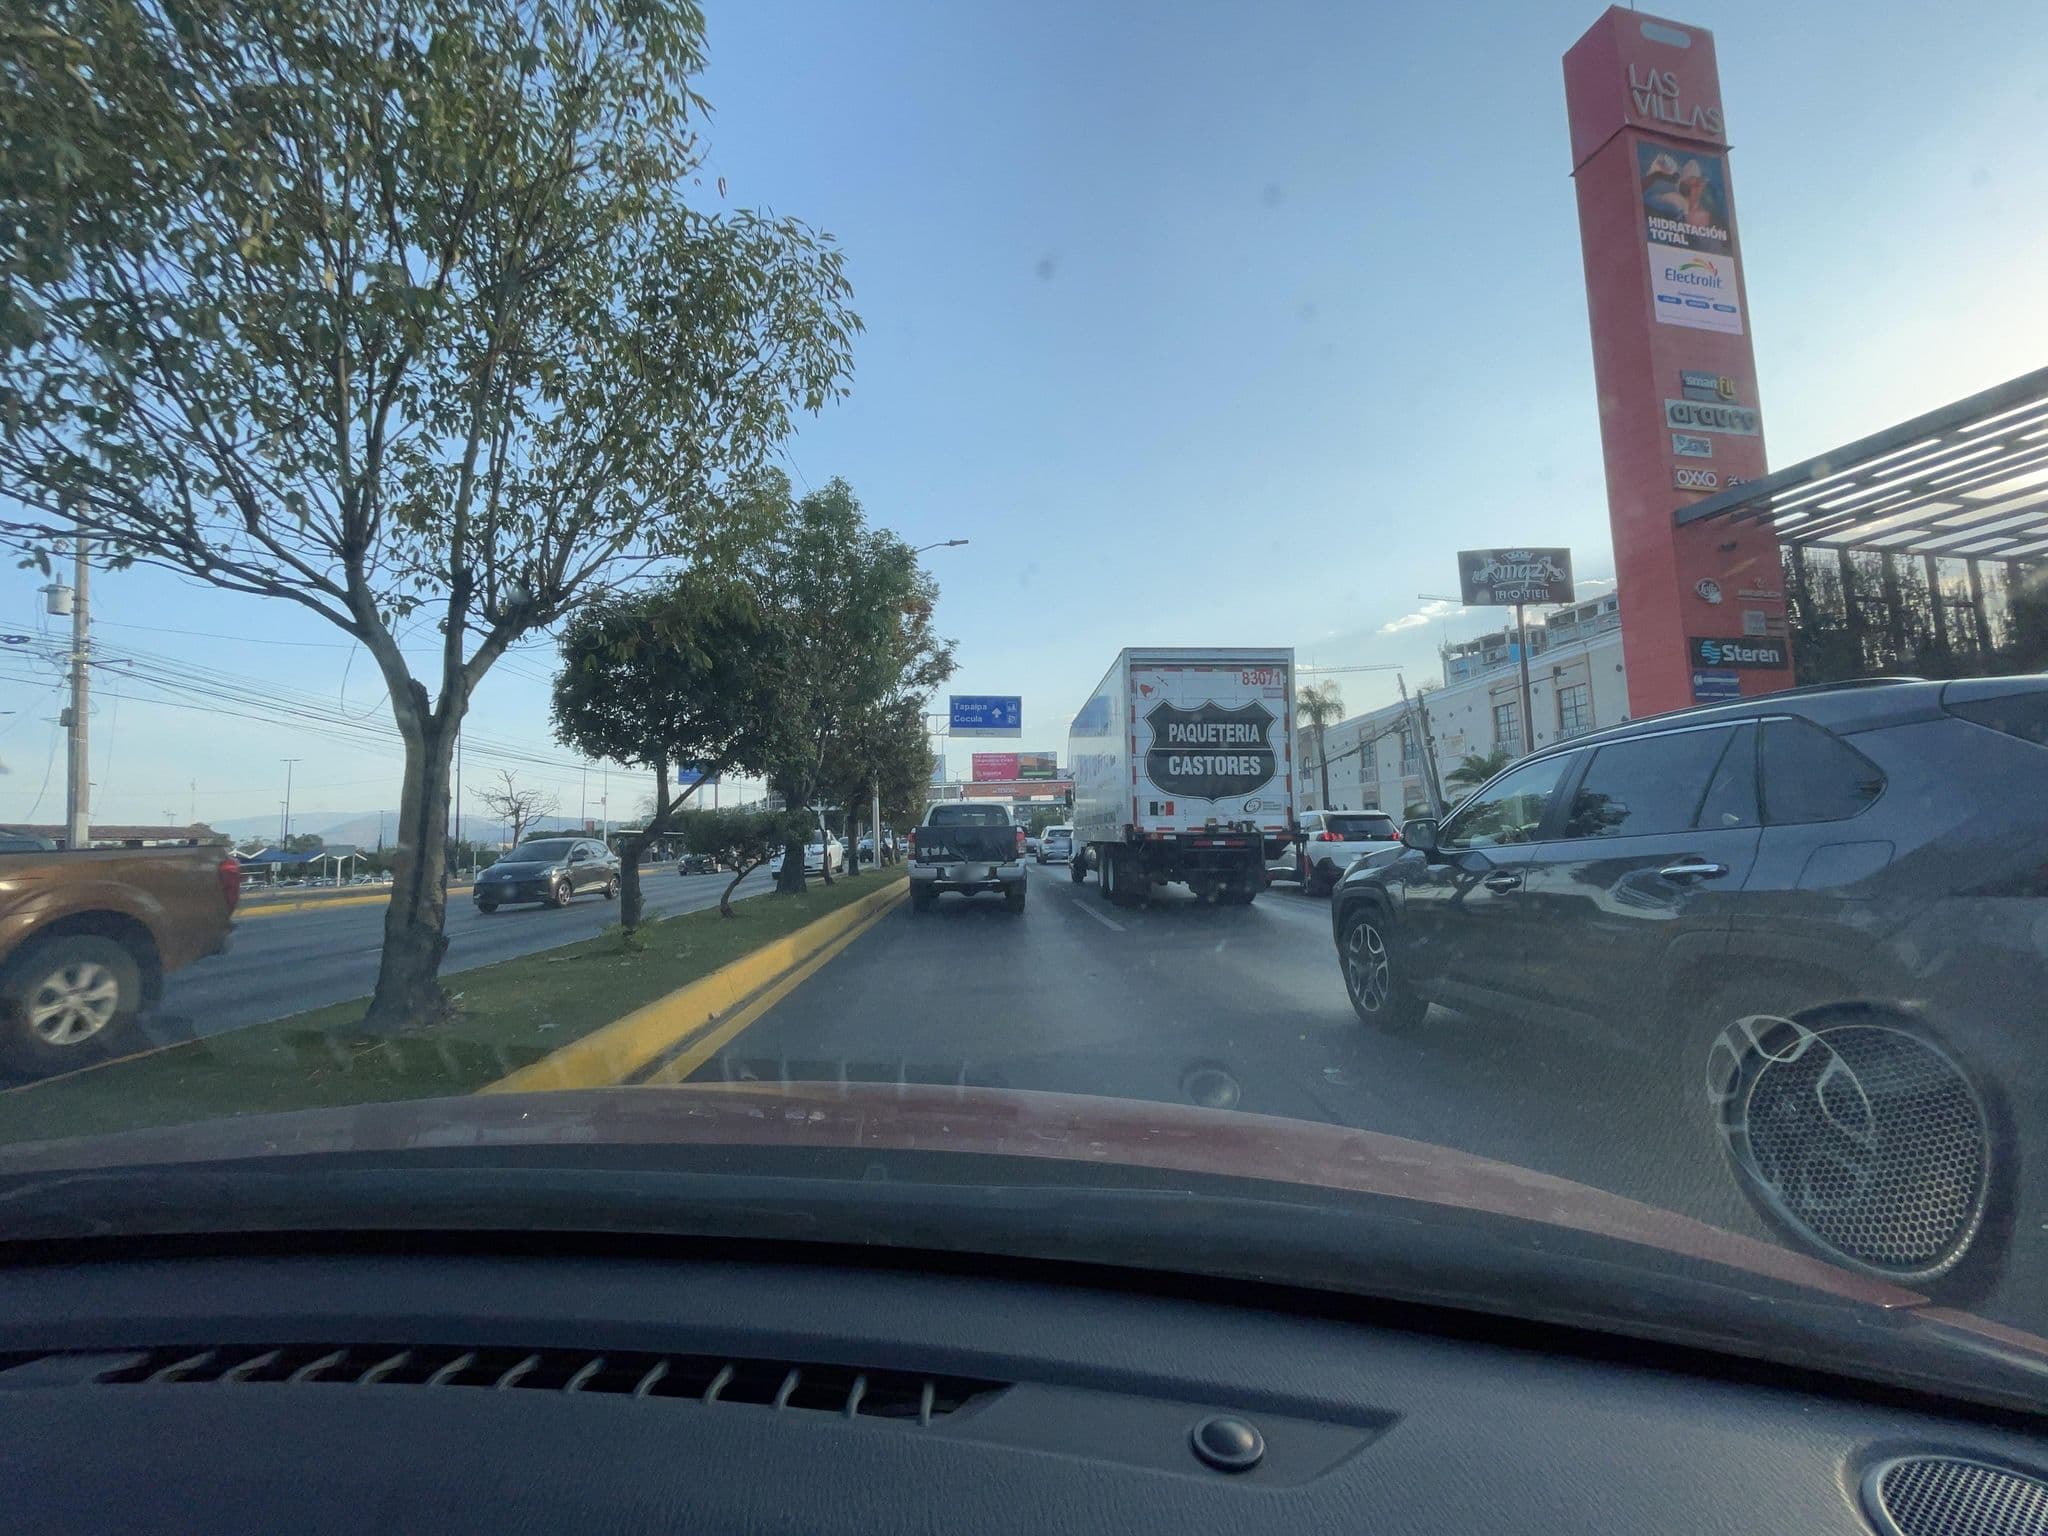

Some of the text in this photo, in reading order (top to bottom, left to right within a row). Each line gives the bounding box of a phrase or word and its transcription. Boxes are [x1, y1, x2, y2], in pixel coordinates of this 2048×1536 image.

[1629, 63, 1680, 98] LAS
[1632, 88, 1722, 134] VILLAS
[1648, 216, 1728, 241] HIDRATACIÓN
[1650, 229, 1689, 246] TOTAL
[1665, 267, 1723, 289] Electrolit
[1677, 469, 1717, 487] OXXO
[1722, 644, 1780, 663] Steren
[1242, 671, 1282, 686] 83071
[953, 702, 988, 712] Tapalpa
[953, 714, 983, 723] Cocula
[1168, 723, 1260, 743] PAQUETERIA
[1168, 756, 1261, 776] CASTORES
